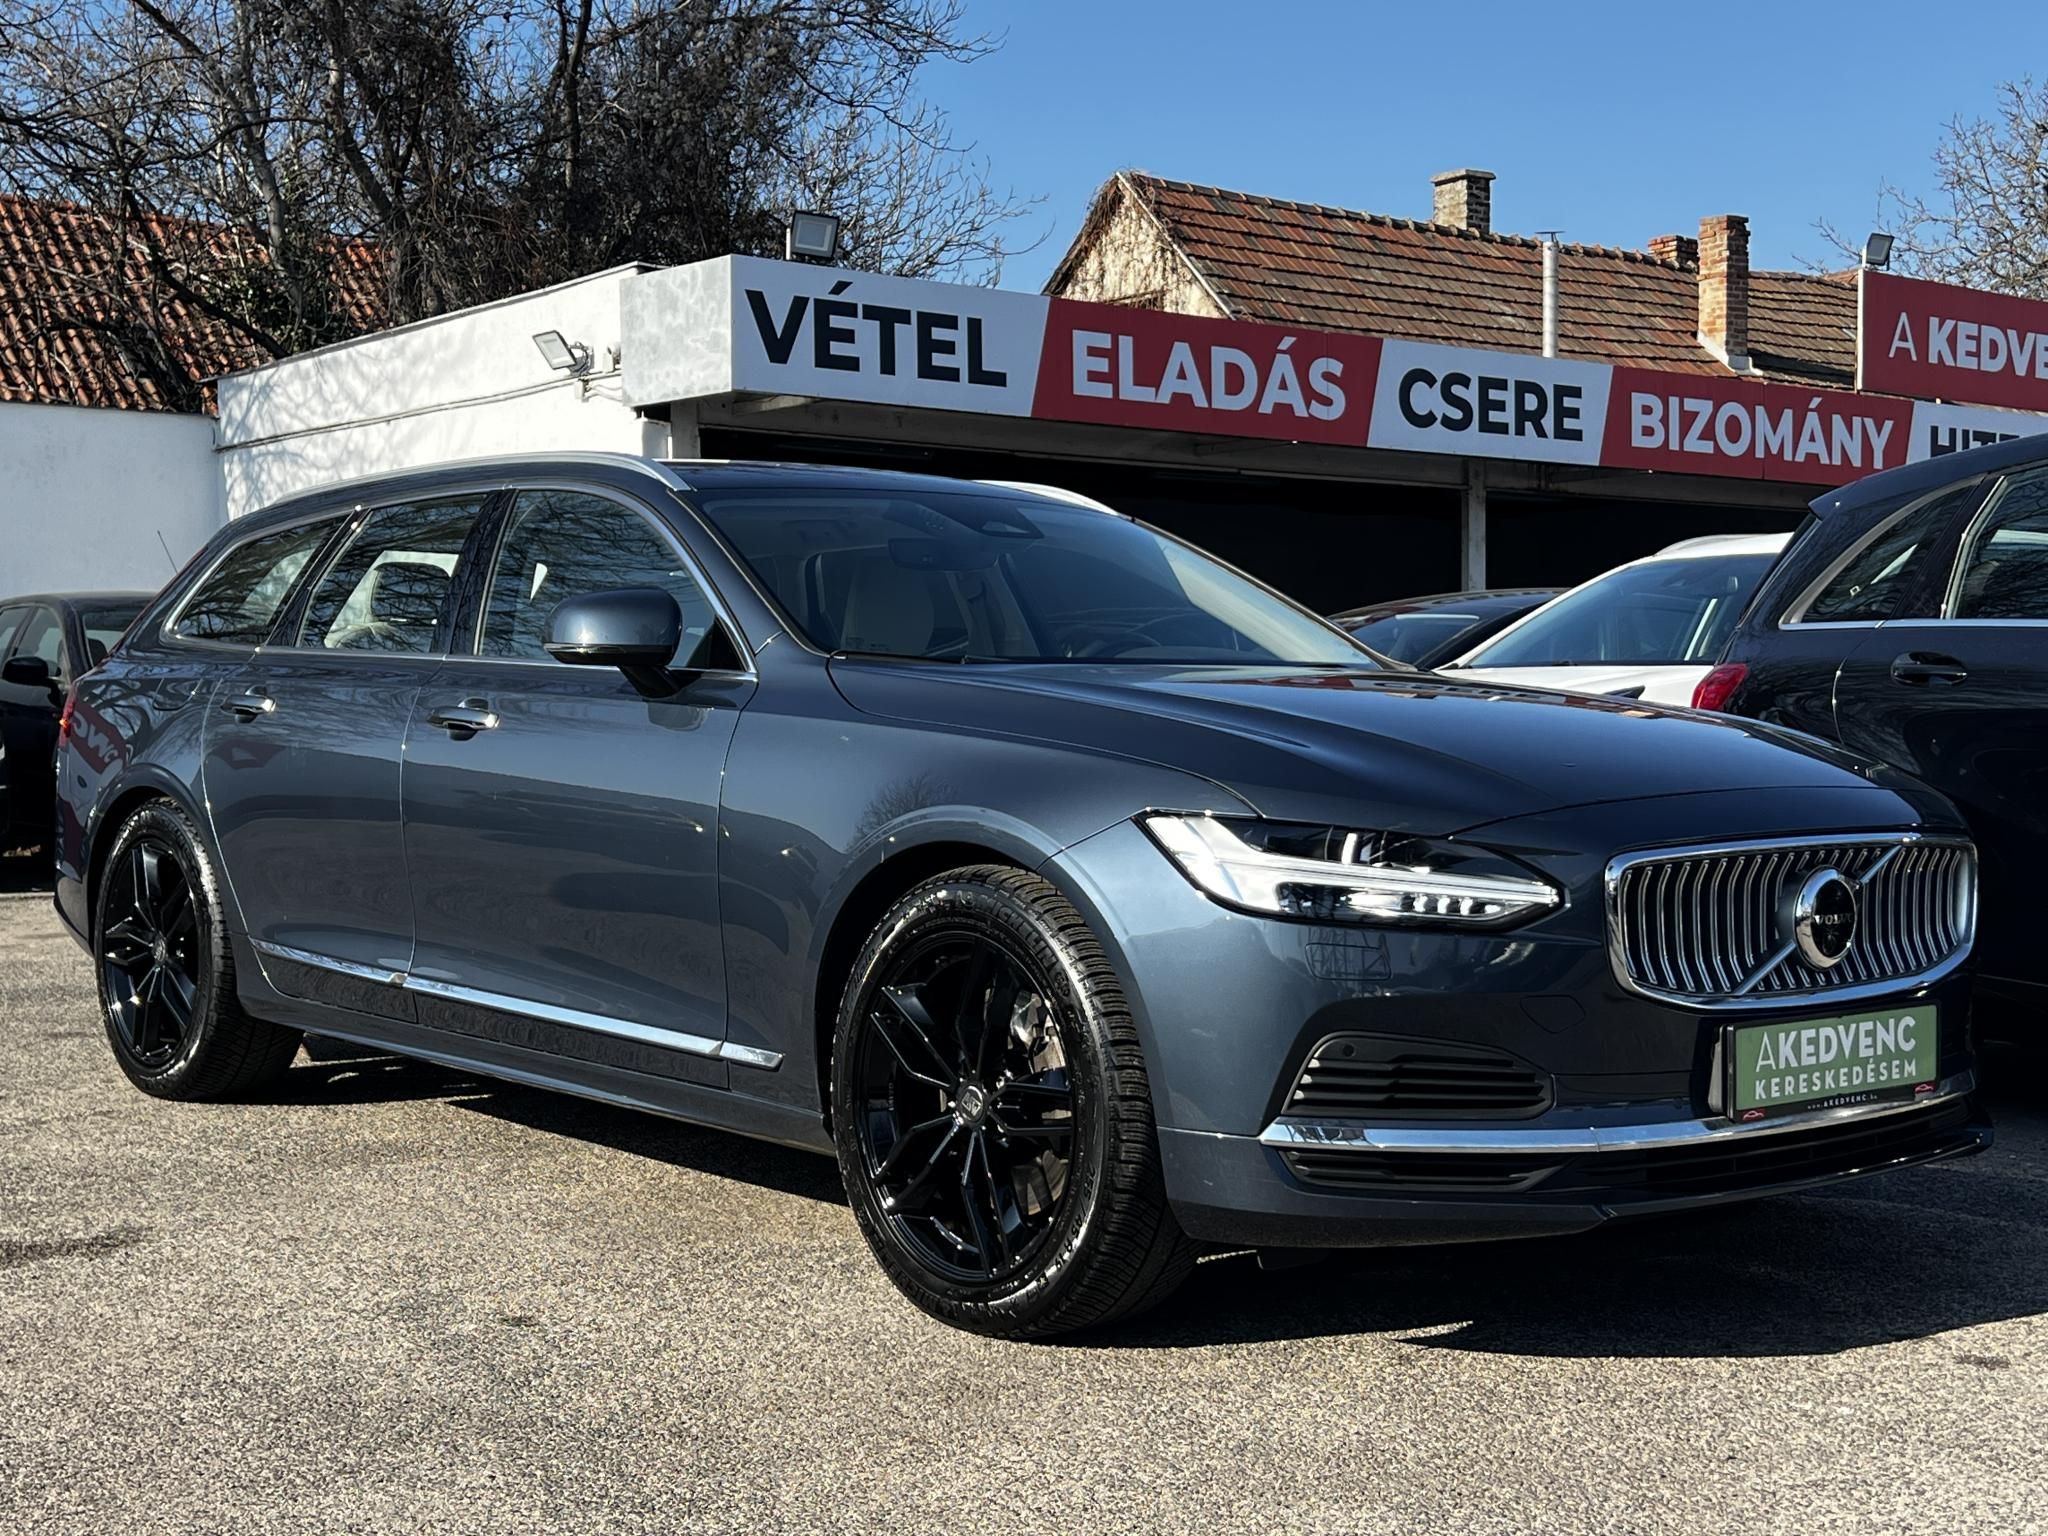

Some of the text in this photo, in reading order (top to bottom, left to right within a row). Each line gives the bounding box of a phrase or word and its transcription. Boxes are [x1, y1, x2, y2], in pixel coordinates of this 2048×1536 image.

[1889, 312, 1917, 361] A
[745, 281, 1007, 388] VÉTEL
[1071, 328, 1346, 421] ELADÁS
[1399, 367, 1584, 442] CSERE
[1631, 392, 1894, 470] BIZOMÁNY
[1755, 1058, 1917, 1100] KERESKEDÉSEM
